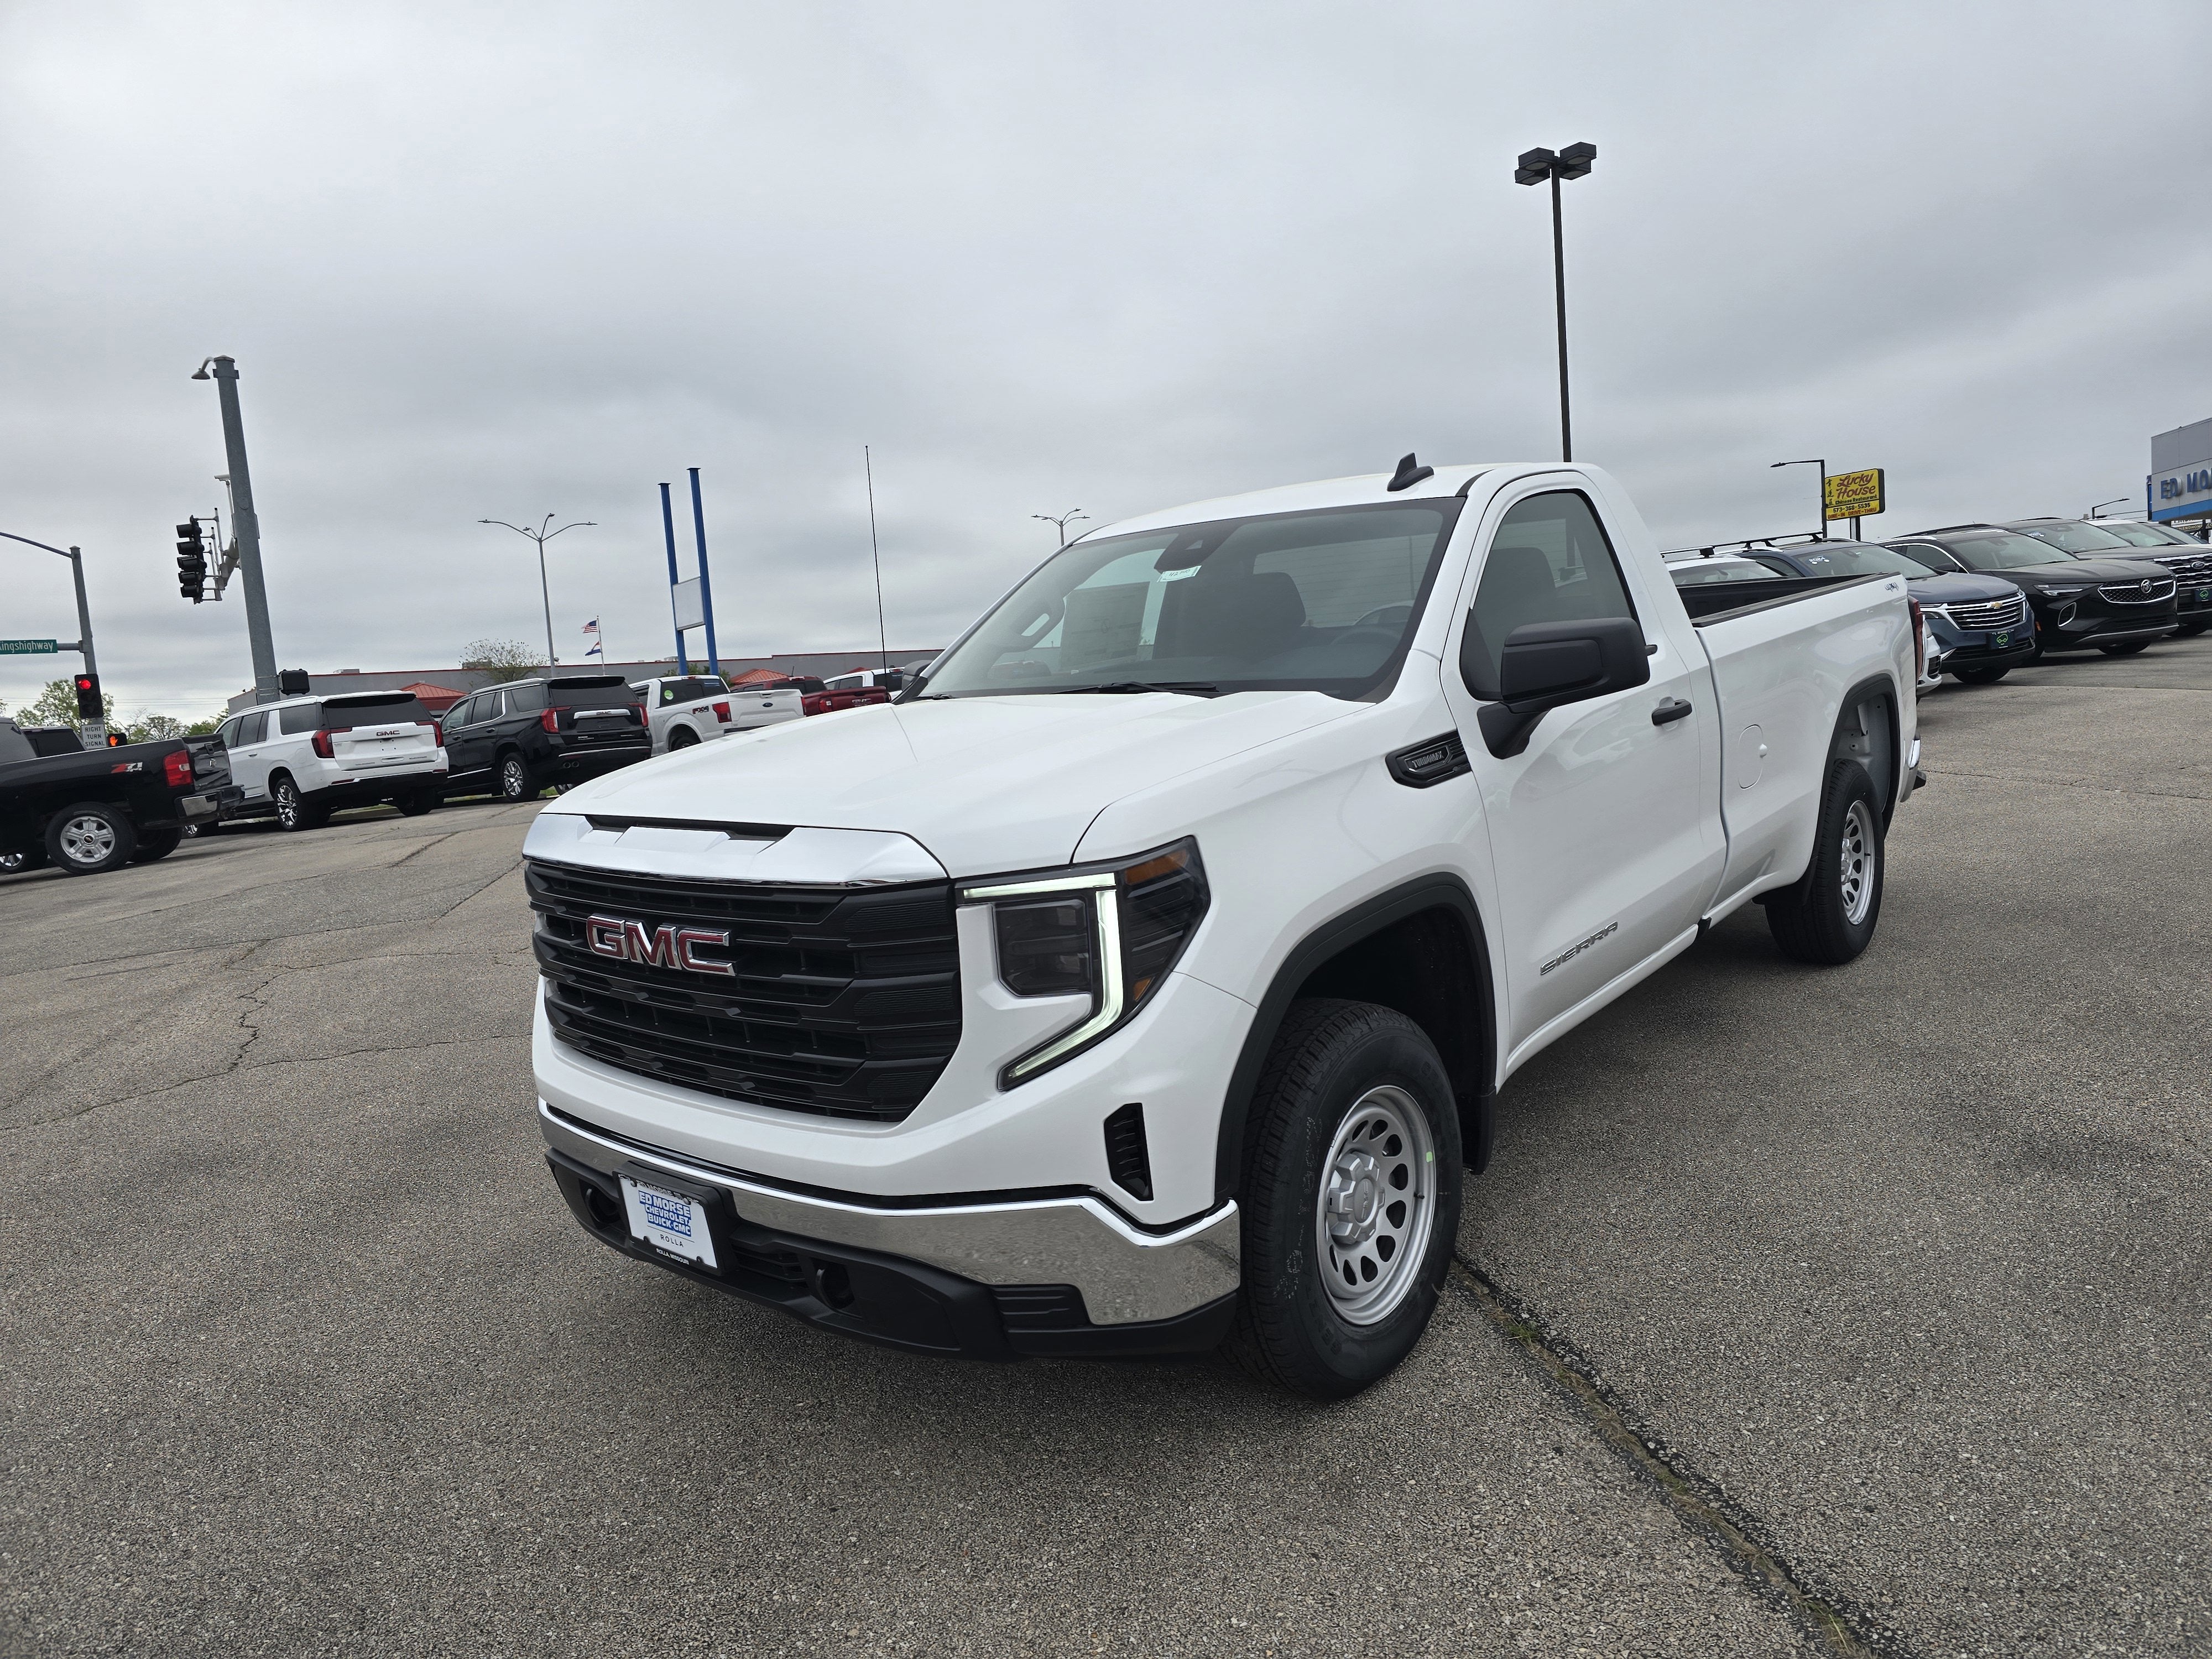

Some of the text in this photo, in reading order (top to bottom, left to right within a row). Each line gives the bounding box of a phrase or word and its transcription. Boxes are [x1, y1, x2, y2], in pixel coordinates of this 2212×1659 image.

[1837, 473, 1874, 487] Lucky
[2161, 468, 2212, 499] ED MO
[1836, 486, 1876, 499] House
[1853, 494, 1877, 502] Restaurant
[692, 705, 709, 714] FX4
[1411, 750, 1444, 768] TURBOMAX
[111, 762, 143, 774] Z71
[586, 914, 736, 977] GMC
[1540, 921, 1618, 975] SIERRA
[639, 1191, 691, 1218] ED MORSE
[660, 1234, 684, 1248] ROLLA
[670, 1253, 690, 1265] MISSOURI
